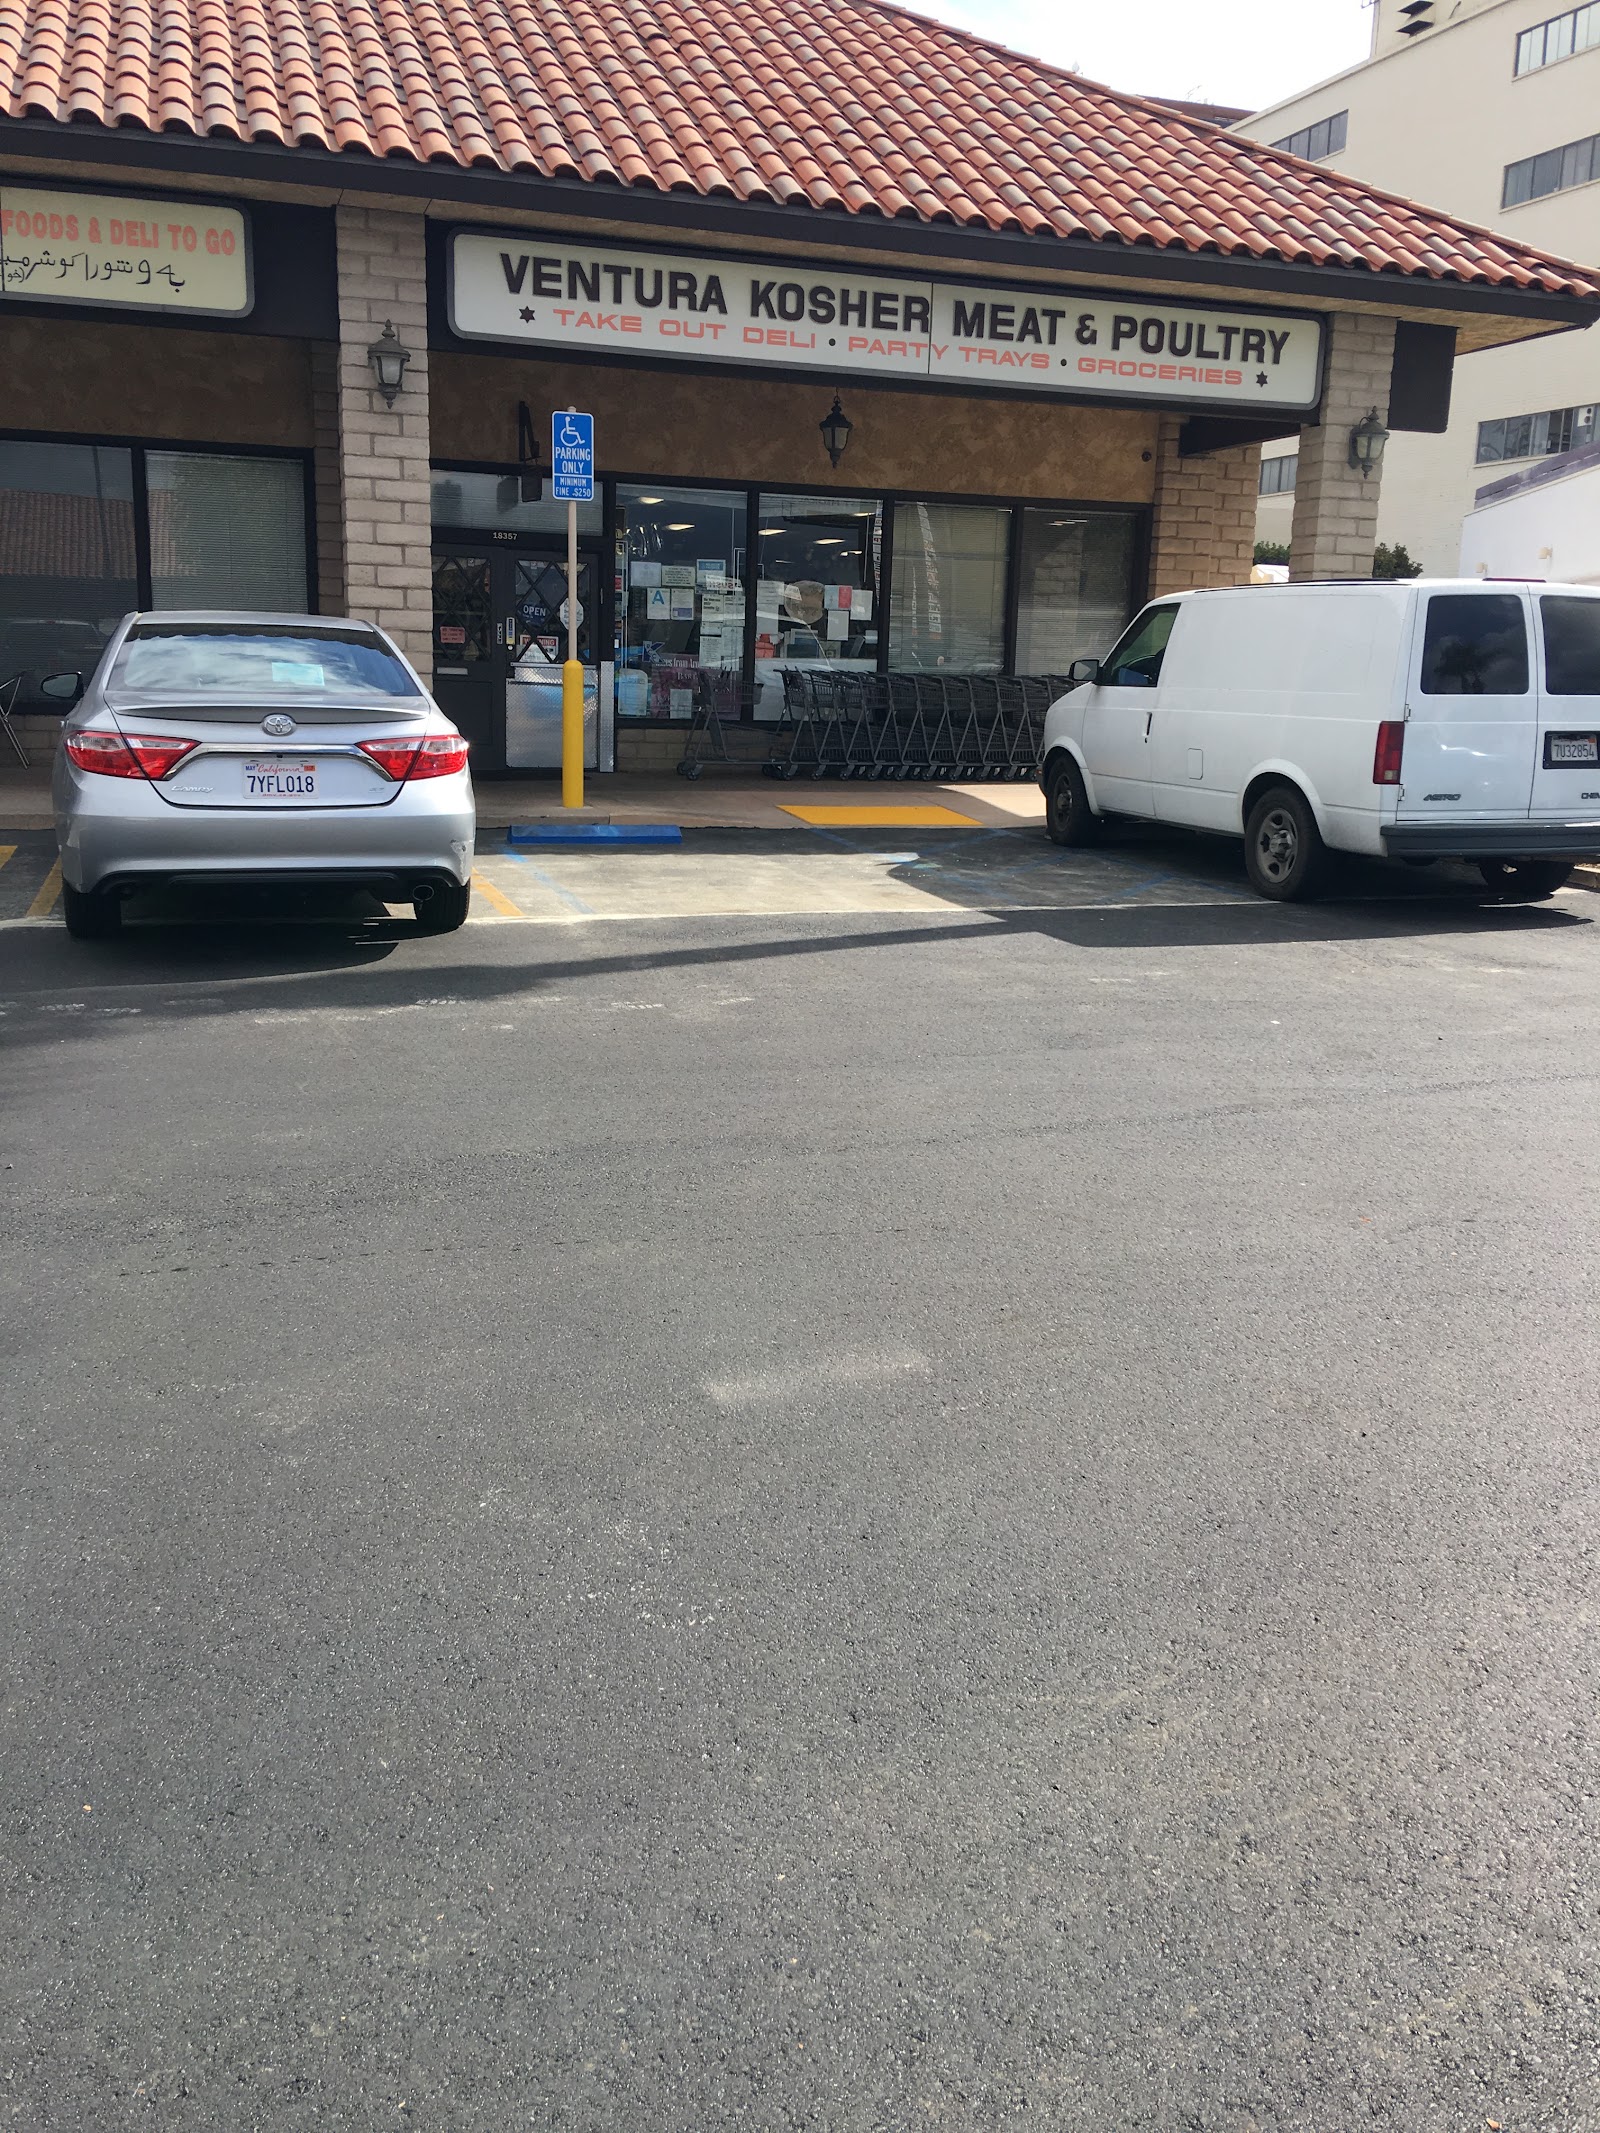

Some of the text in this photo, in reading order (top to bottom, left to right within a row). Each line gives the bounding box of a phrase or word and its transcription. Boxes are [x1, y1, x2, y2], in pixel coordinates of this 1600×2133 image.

[0, 209, 236, 256] FOODS & DELI TO GO
[500, 253, 1290, 365] VENTURA KOSHER MEAT & POULTRY
[553, 308, 1243, 385] TAKE OUT DELI PARTY TRAYS GROCERIES
[555, 447, 591, 461] PARKING
[562, 460, 584, 474] ONLY
[560, 477, 587, 487] MINIMUM
[556, 487, 569, 496] FINE
[493, 532, 518, 541] 18357
[523, 605, 546, 617] OPEN
[524, 637, 555, 646] WNING
[257, 764, 303, 775] California
[247, 775, 314, 793] 7YFL018
[1423, 793, 1462, 801] ASTRO
